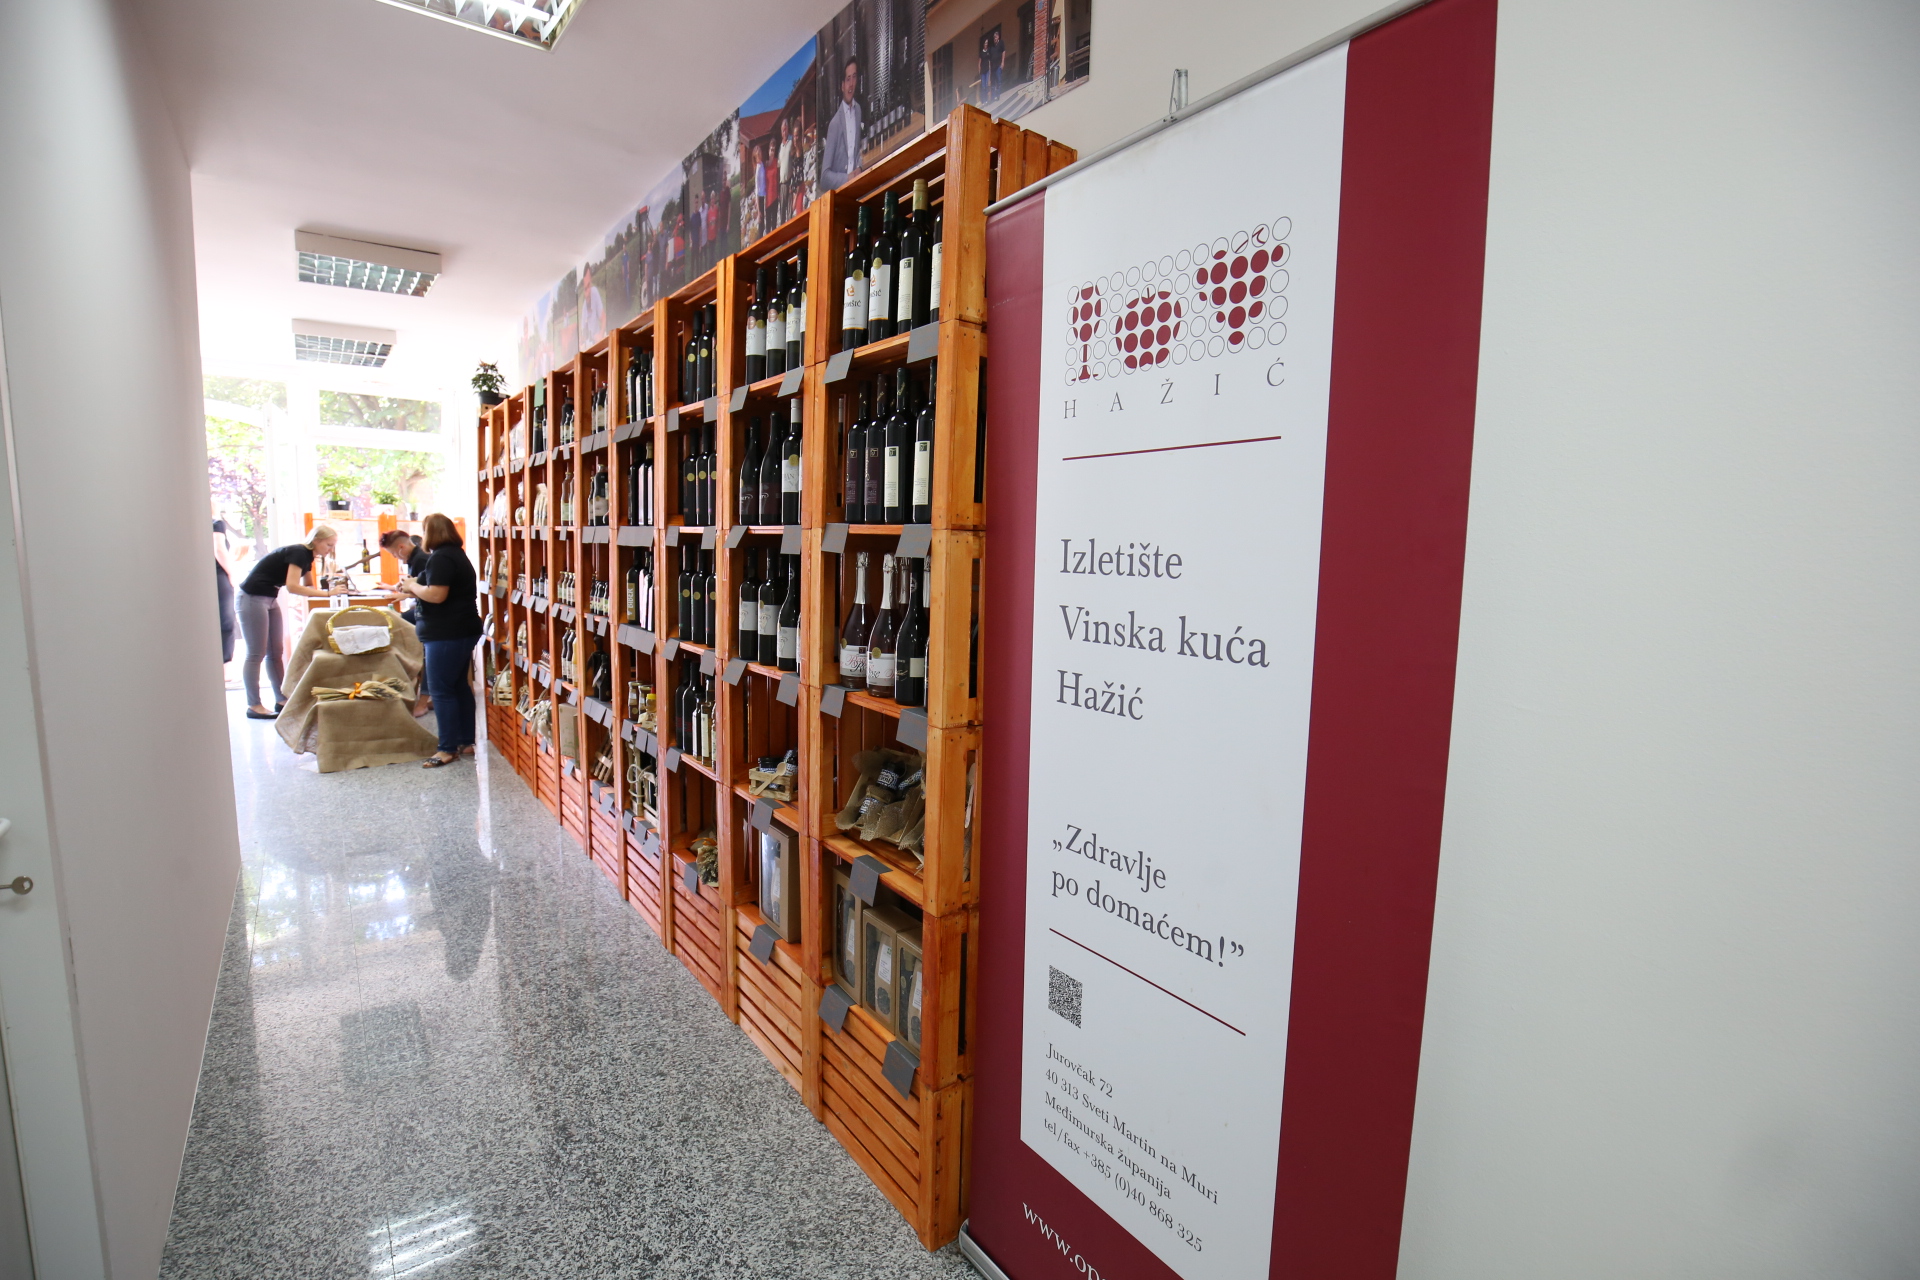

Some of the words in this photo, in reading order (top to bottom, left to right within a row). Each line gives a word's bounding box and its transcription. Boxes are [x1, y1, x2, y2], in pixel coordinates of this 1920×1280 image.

[1059, 537, 1183, 580] Izletište
[1059, 604, 1167, 653] Vinska
[1177, 615, 1270, 668] kuća
[1056, 669, 1144, 721] Hažić
[1051, 870, 1079, 898] po
[1045, 1042, 1096, 1087] Jurovčak
[1099, 1077, 1113, 1098] 72
[1044, 1090, 1115, 1155] Međimurska
[1117, 1149, 1172, 1200] županija
[1045, 1067, 1058, 1085] 40
[1060, 1077, 1079, 1100] 313
[1082, 1093, 1110, 1124] Sveti
[1112, 1115, 1157, 1160] Martin
[1160, 1154, 1177, 1175] na
[1181, 1165, 1219, 1205] Muri
[1043, 1117, 1081, 1155] tel/fax
[1083, 1149, 1111, 1179] +385
[1114, 1172, 1146, 1207] (0)40
[1149, 1199, 1173, 1230] 868
[1176, 1222, 1203, 1252] 325
[1022, 1202, 1107, 1280] www.op
